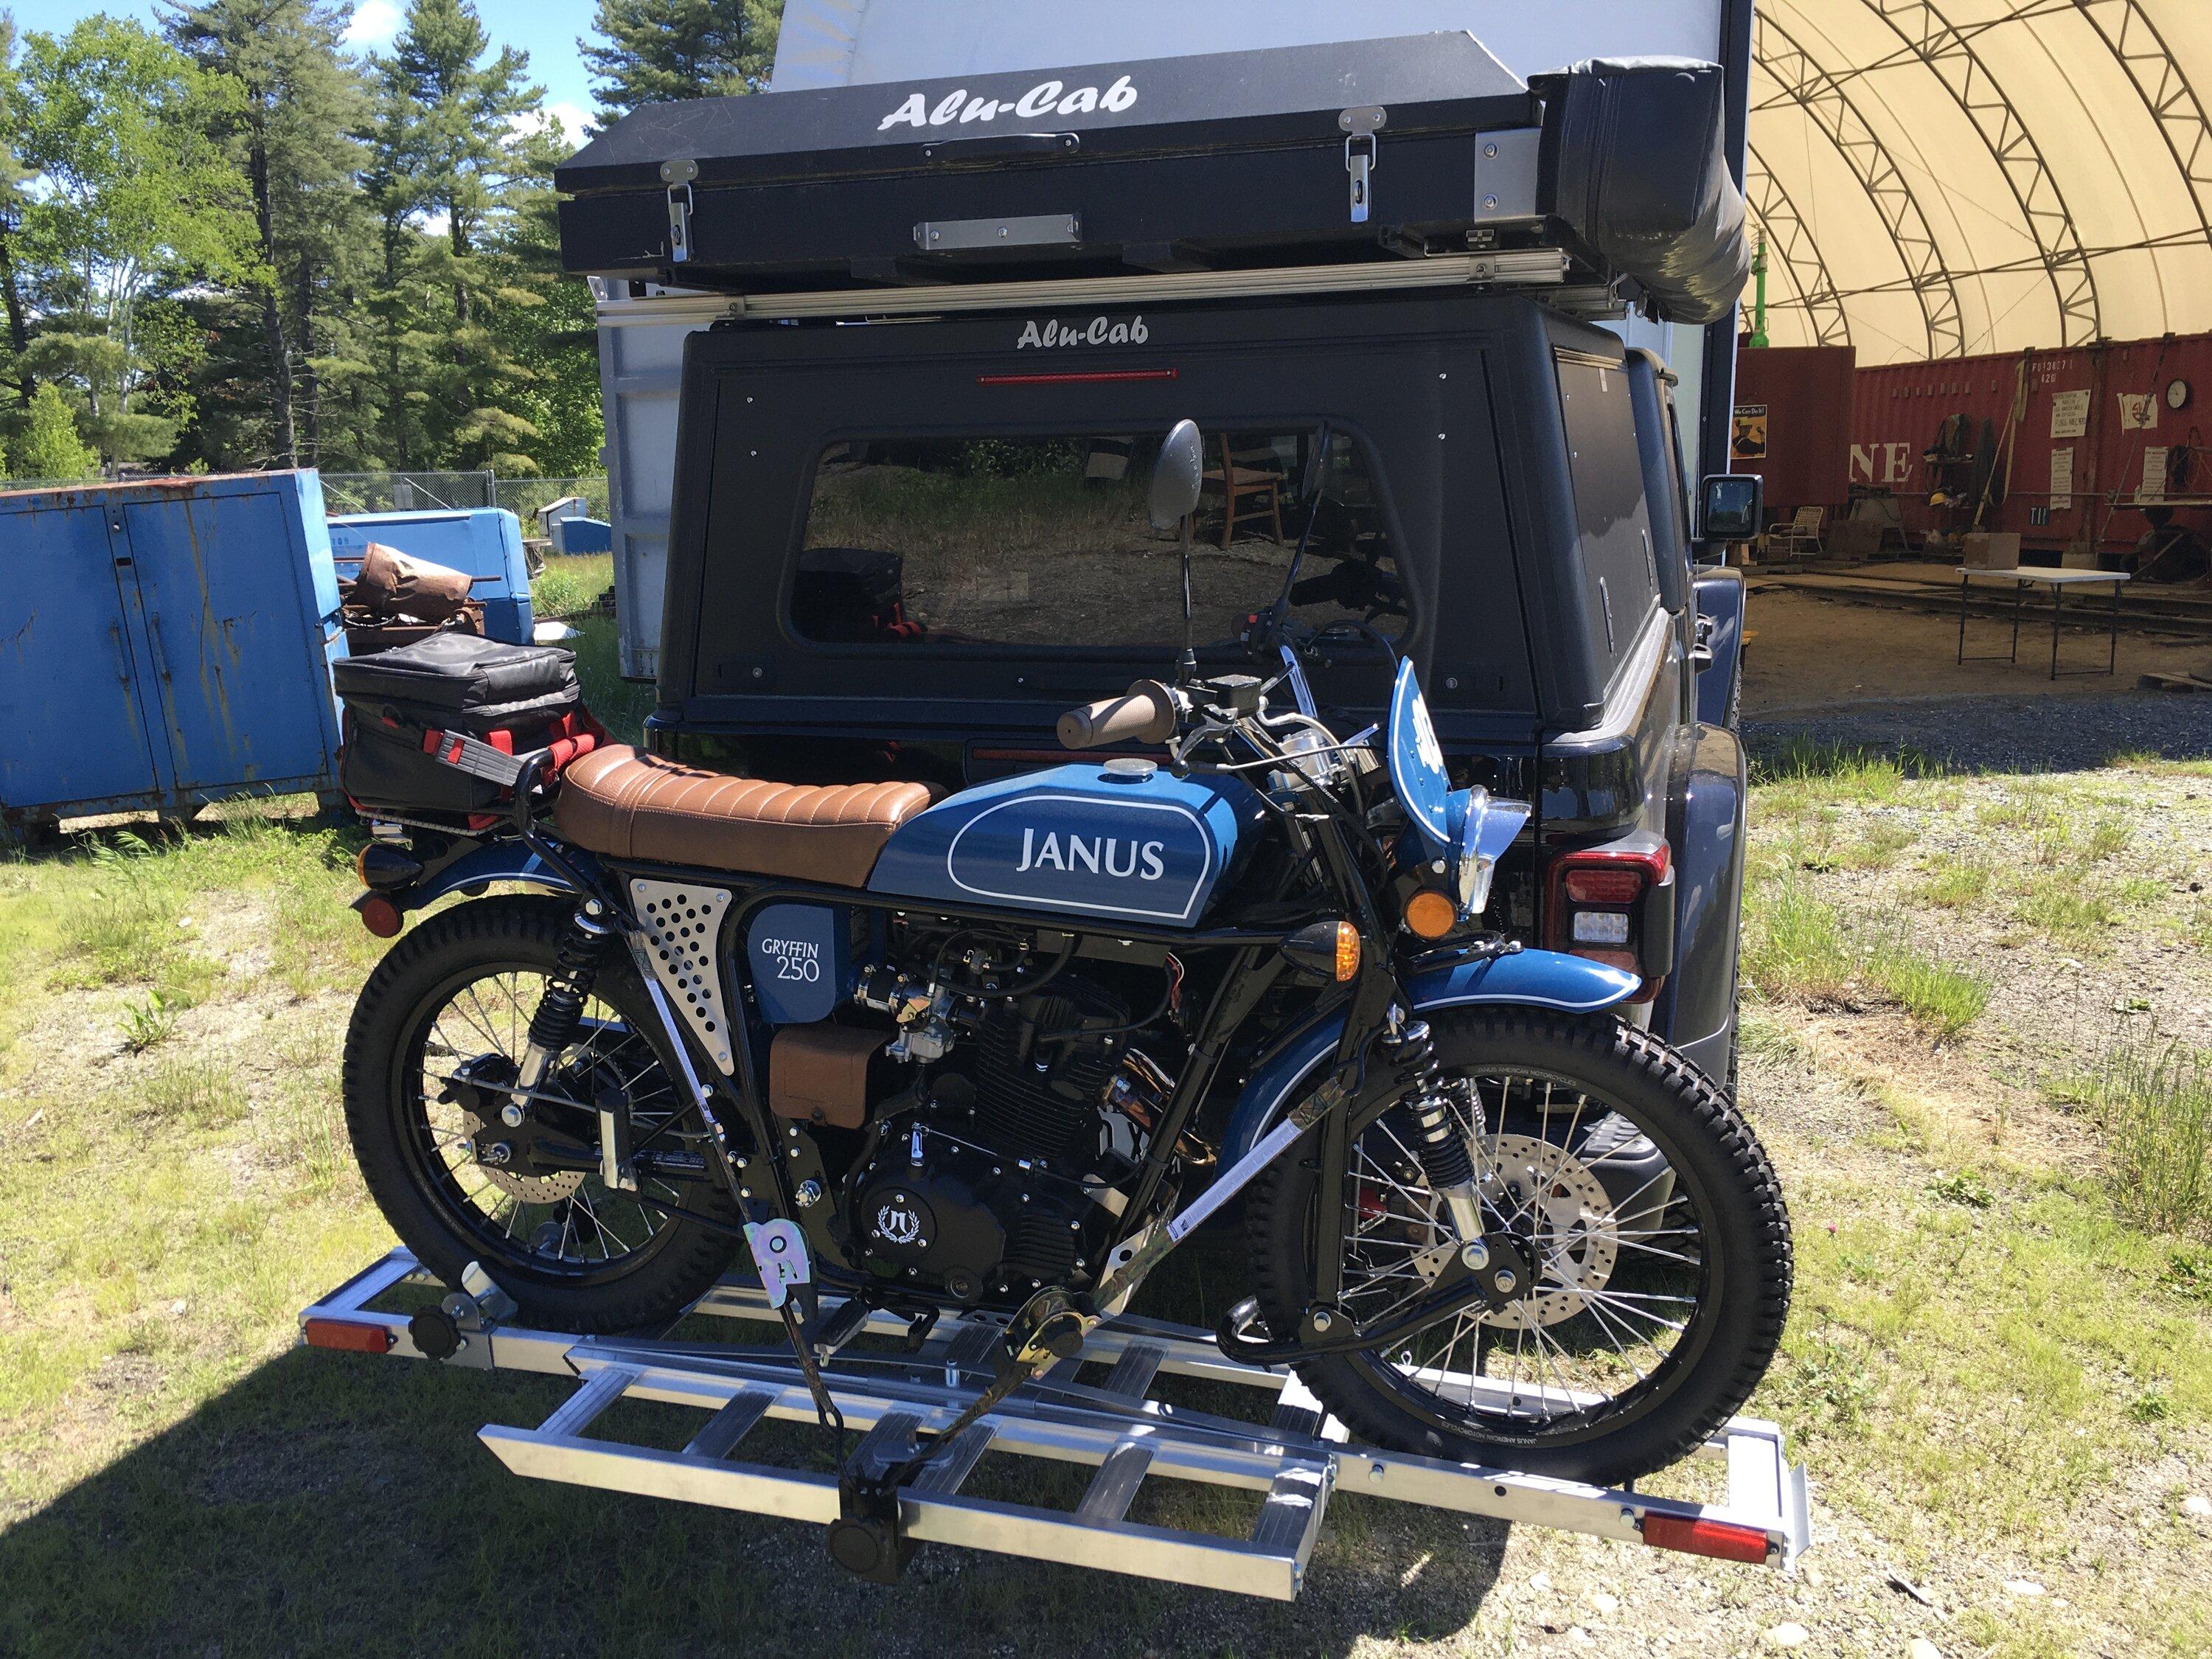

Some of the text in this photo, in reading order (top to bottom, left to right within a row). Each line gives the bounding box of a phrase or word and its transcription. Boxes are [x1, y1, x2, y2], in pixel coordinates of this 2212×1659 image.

[877, 74, 1138, 131] Alu-Cab
[1016, 315, 1149, 349] Alu-Cab
[1015, 827, 1165, 881] JANUS
[762, 938, 819, 959] GRYFFIN
[776, 956, 820, 982] 250
[1498, 1067, 1528, 1075] AMERICAN
[1530, 1070, 1577, 1087] MOTORCYCLES
